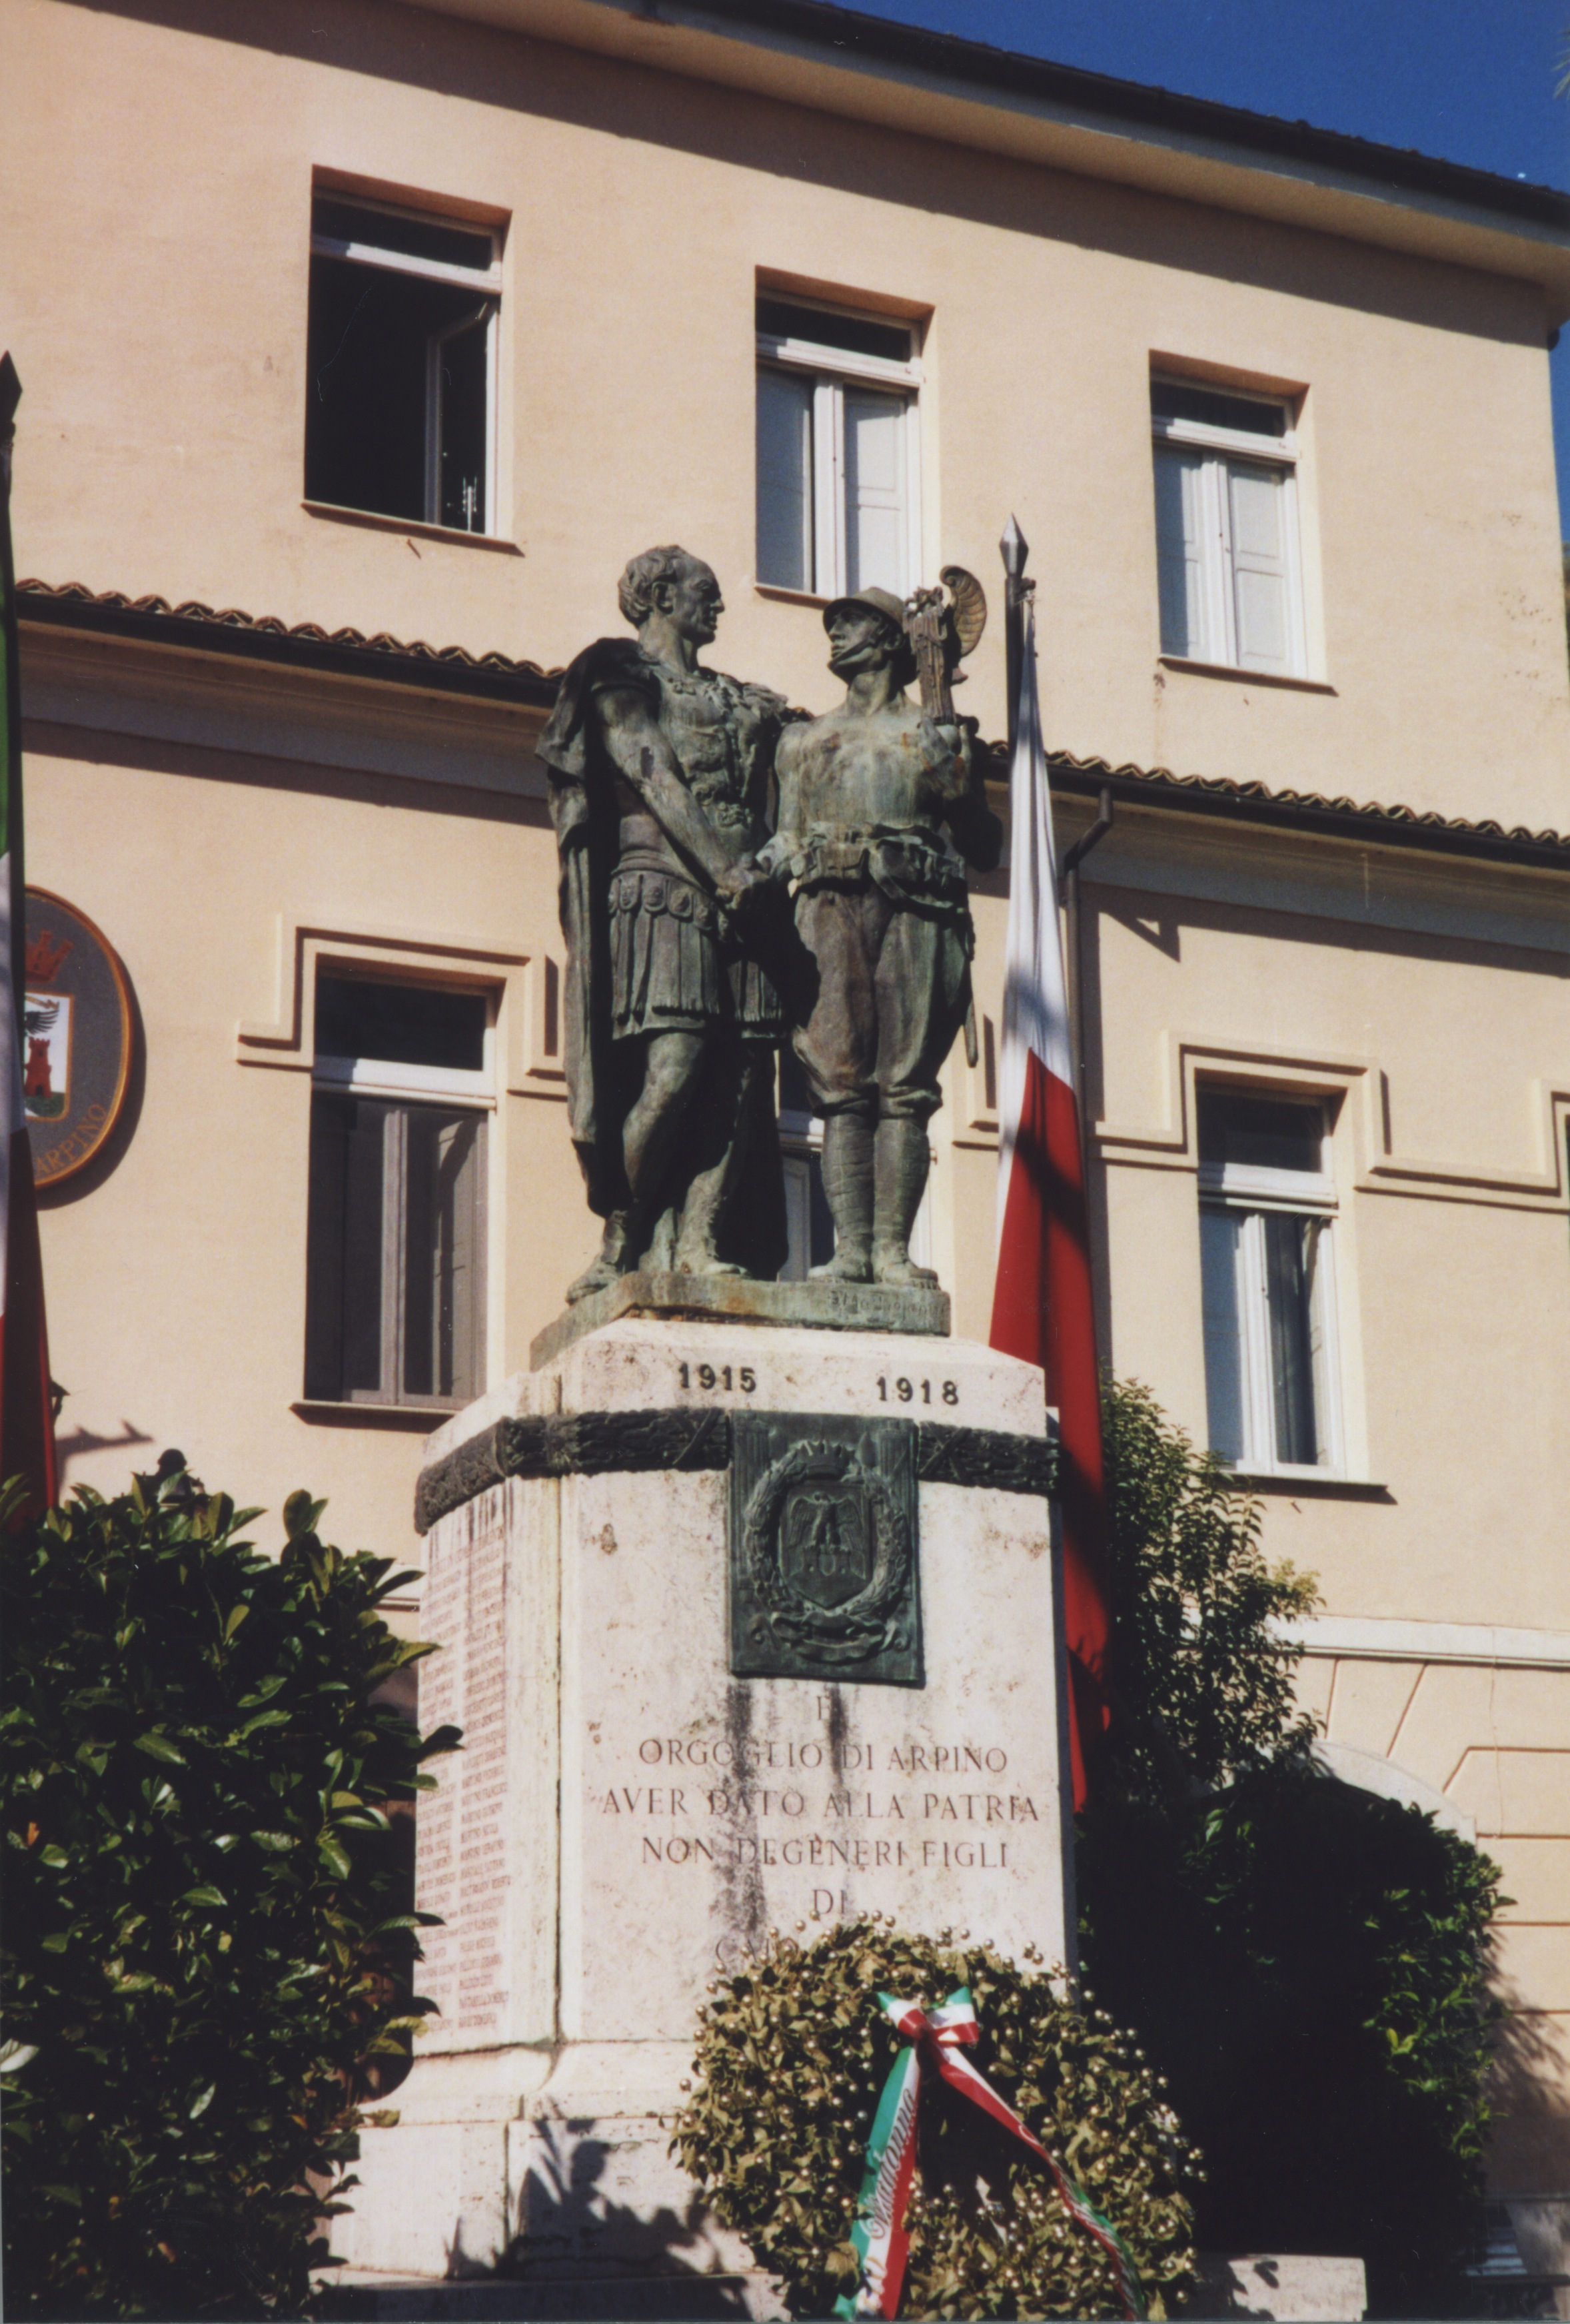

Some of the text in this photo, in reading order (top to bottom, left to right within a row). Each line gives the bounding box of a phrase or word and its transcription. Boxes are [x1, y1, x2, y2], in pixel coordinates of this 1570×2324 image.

[35, 1103, 107, 1177] ARPINO
[678, 1363, 959, 1405] 1915 1918
[639, 1739, 1007, 1772] ORGOGLIO DI ARPINO
[602, 1788, 1039, 1821] AVER DATO ALLA PATRIA
[642, 1837, 1007, 1868] NON DEGENERI FIGLI
[812, 1889, 845, 1914] DI
